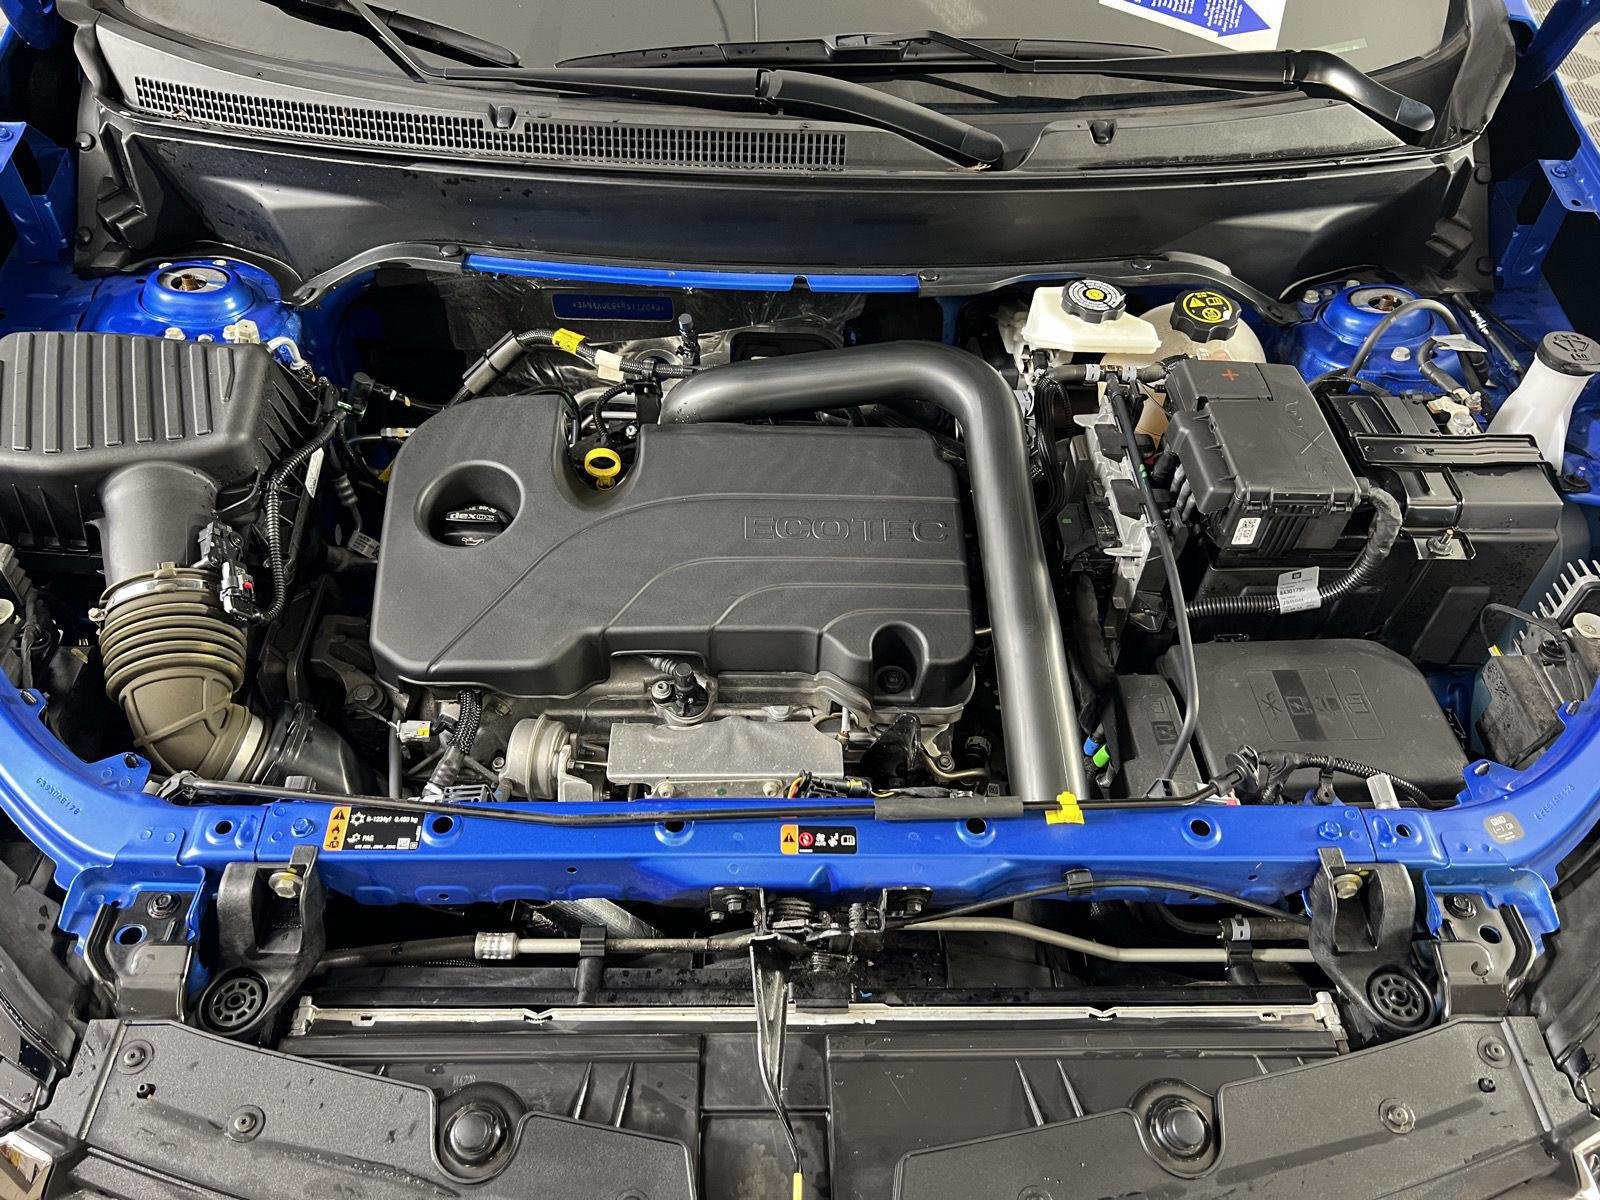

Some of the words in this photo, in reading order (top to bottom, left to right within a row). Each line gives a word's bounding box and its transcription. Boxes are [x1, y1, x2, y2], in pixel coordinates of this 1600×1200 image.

[744, 515, 949, 543] ECOTEC
[410, 816, 418, 824] kg
[362, 834, 375, 842] PAG
